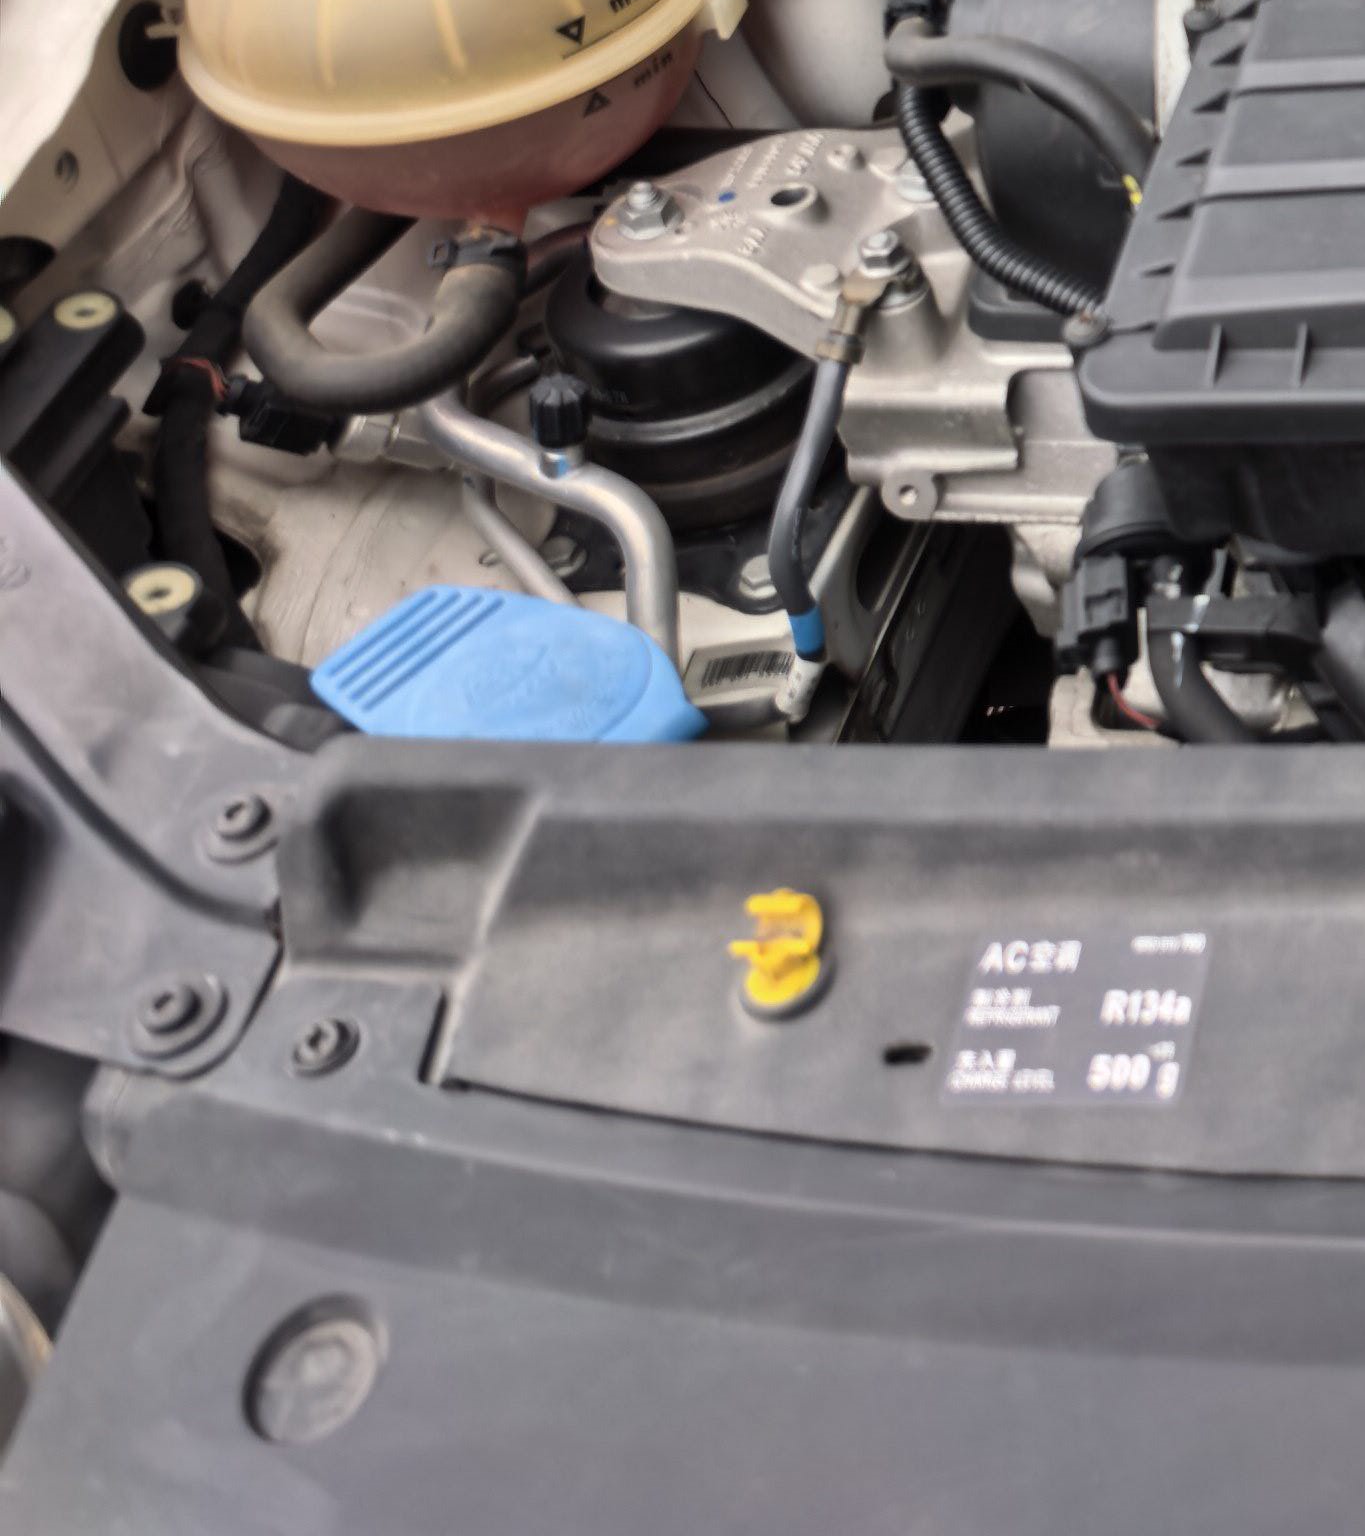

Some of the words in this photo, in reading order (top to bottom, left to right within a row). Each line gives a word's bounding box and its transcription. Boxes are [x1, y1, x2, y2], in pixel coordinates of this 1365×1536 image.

[633, 49, 674, 89] min
[1100, 988, 1193, 1026] R134a
[1086, 1053, 1151, 1092] 500
